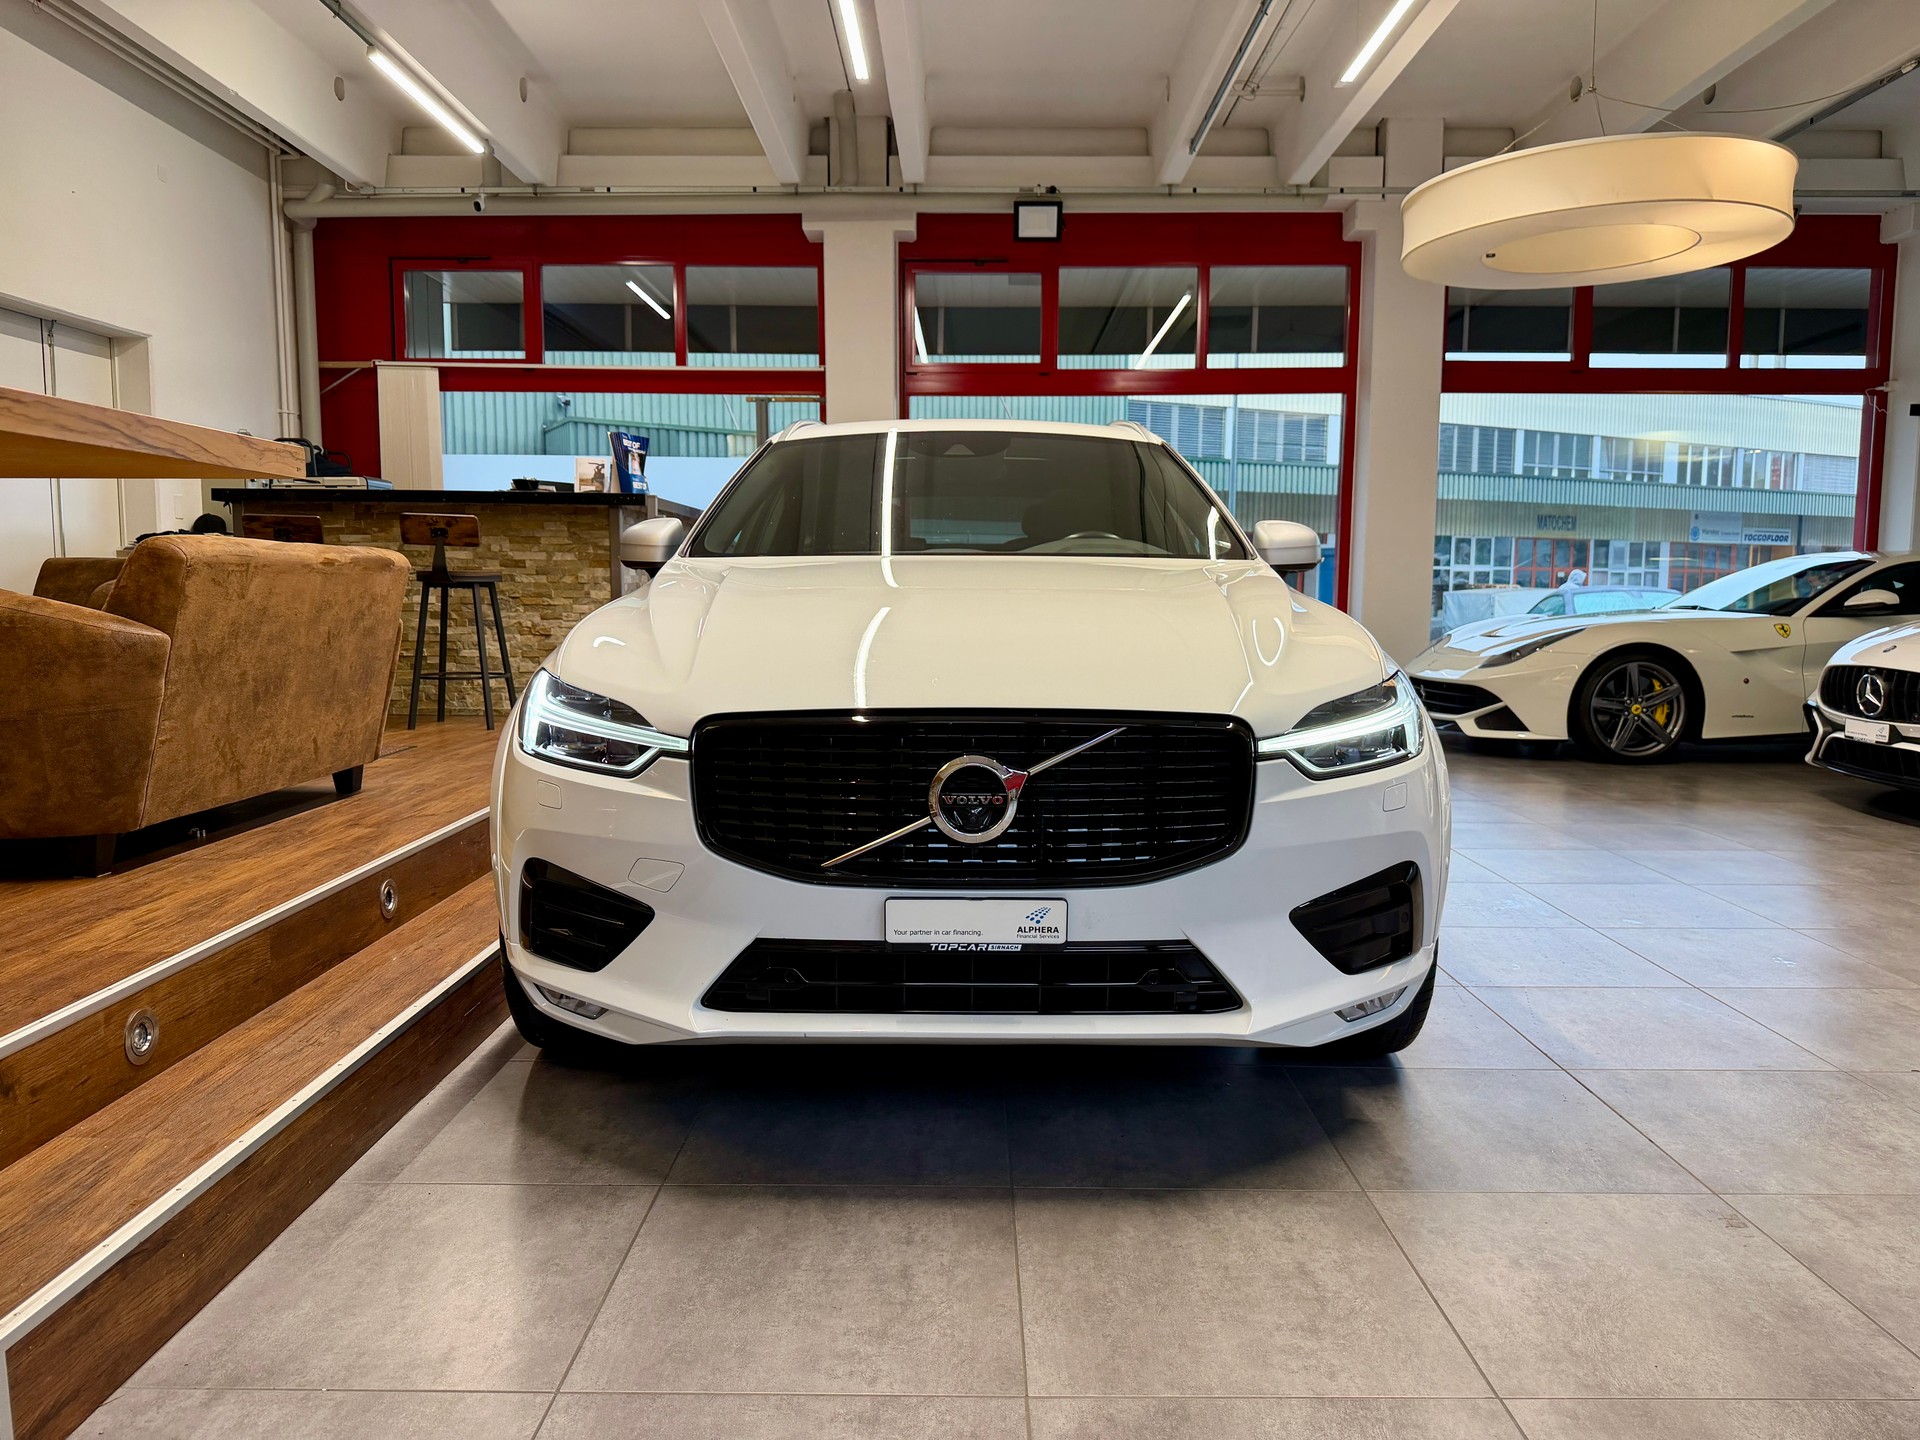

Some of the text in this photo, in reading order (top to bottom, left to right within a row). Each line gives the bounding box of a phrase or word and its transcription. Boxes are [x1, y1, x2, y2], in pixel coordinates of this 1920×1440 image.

[942, 795, 1004, 805] VOLVO
[909, 929, 932, 937] partner
[952, 929, 984, 937] financing.
[1017, 926, 1060, 934] ALPHERA
[930, 943, 988, 951] TOPCAR
